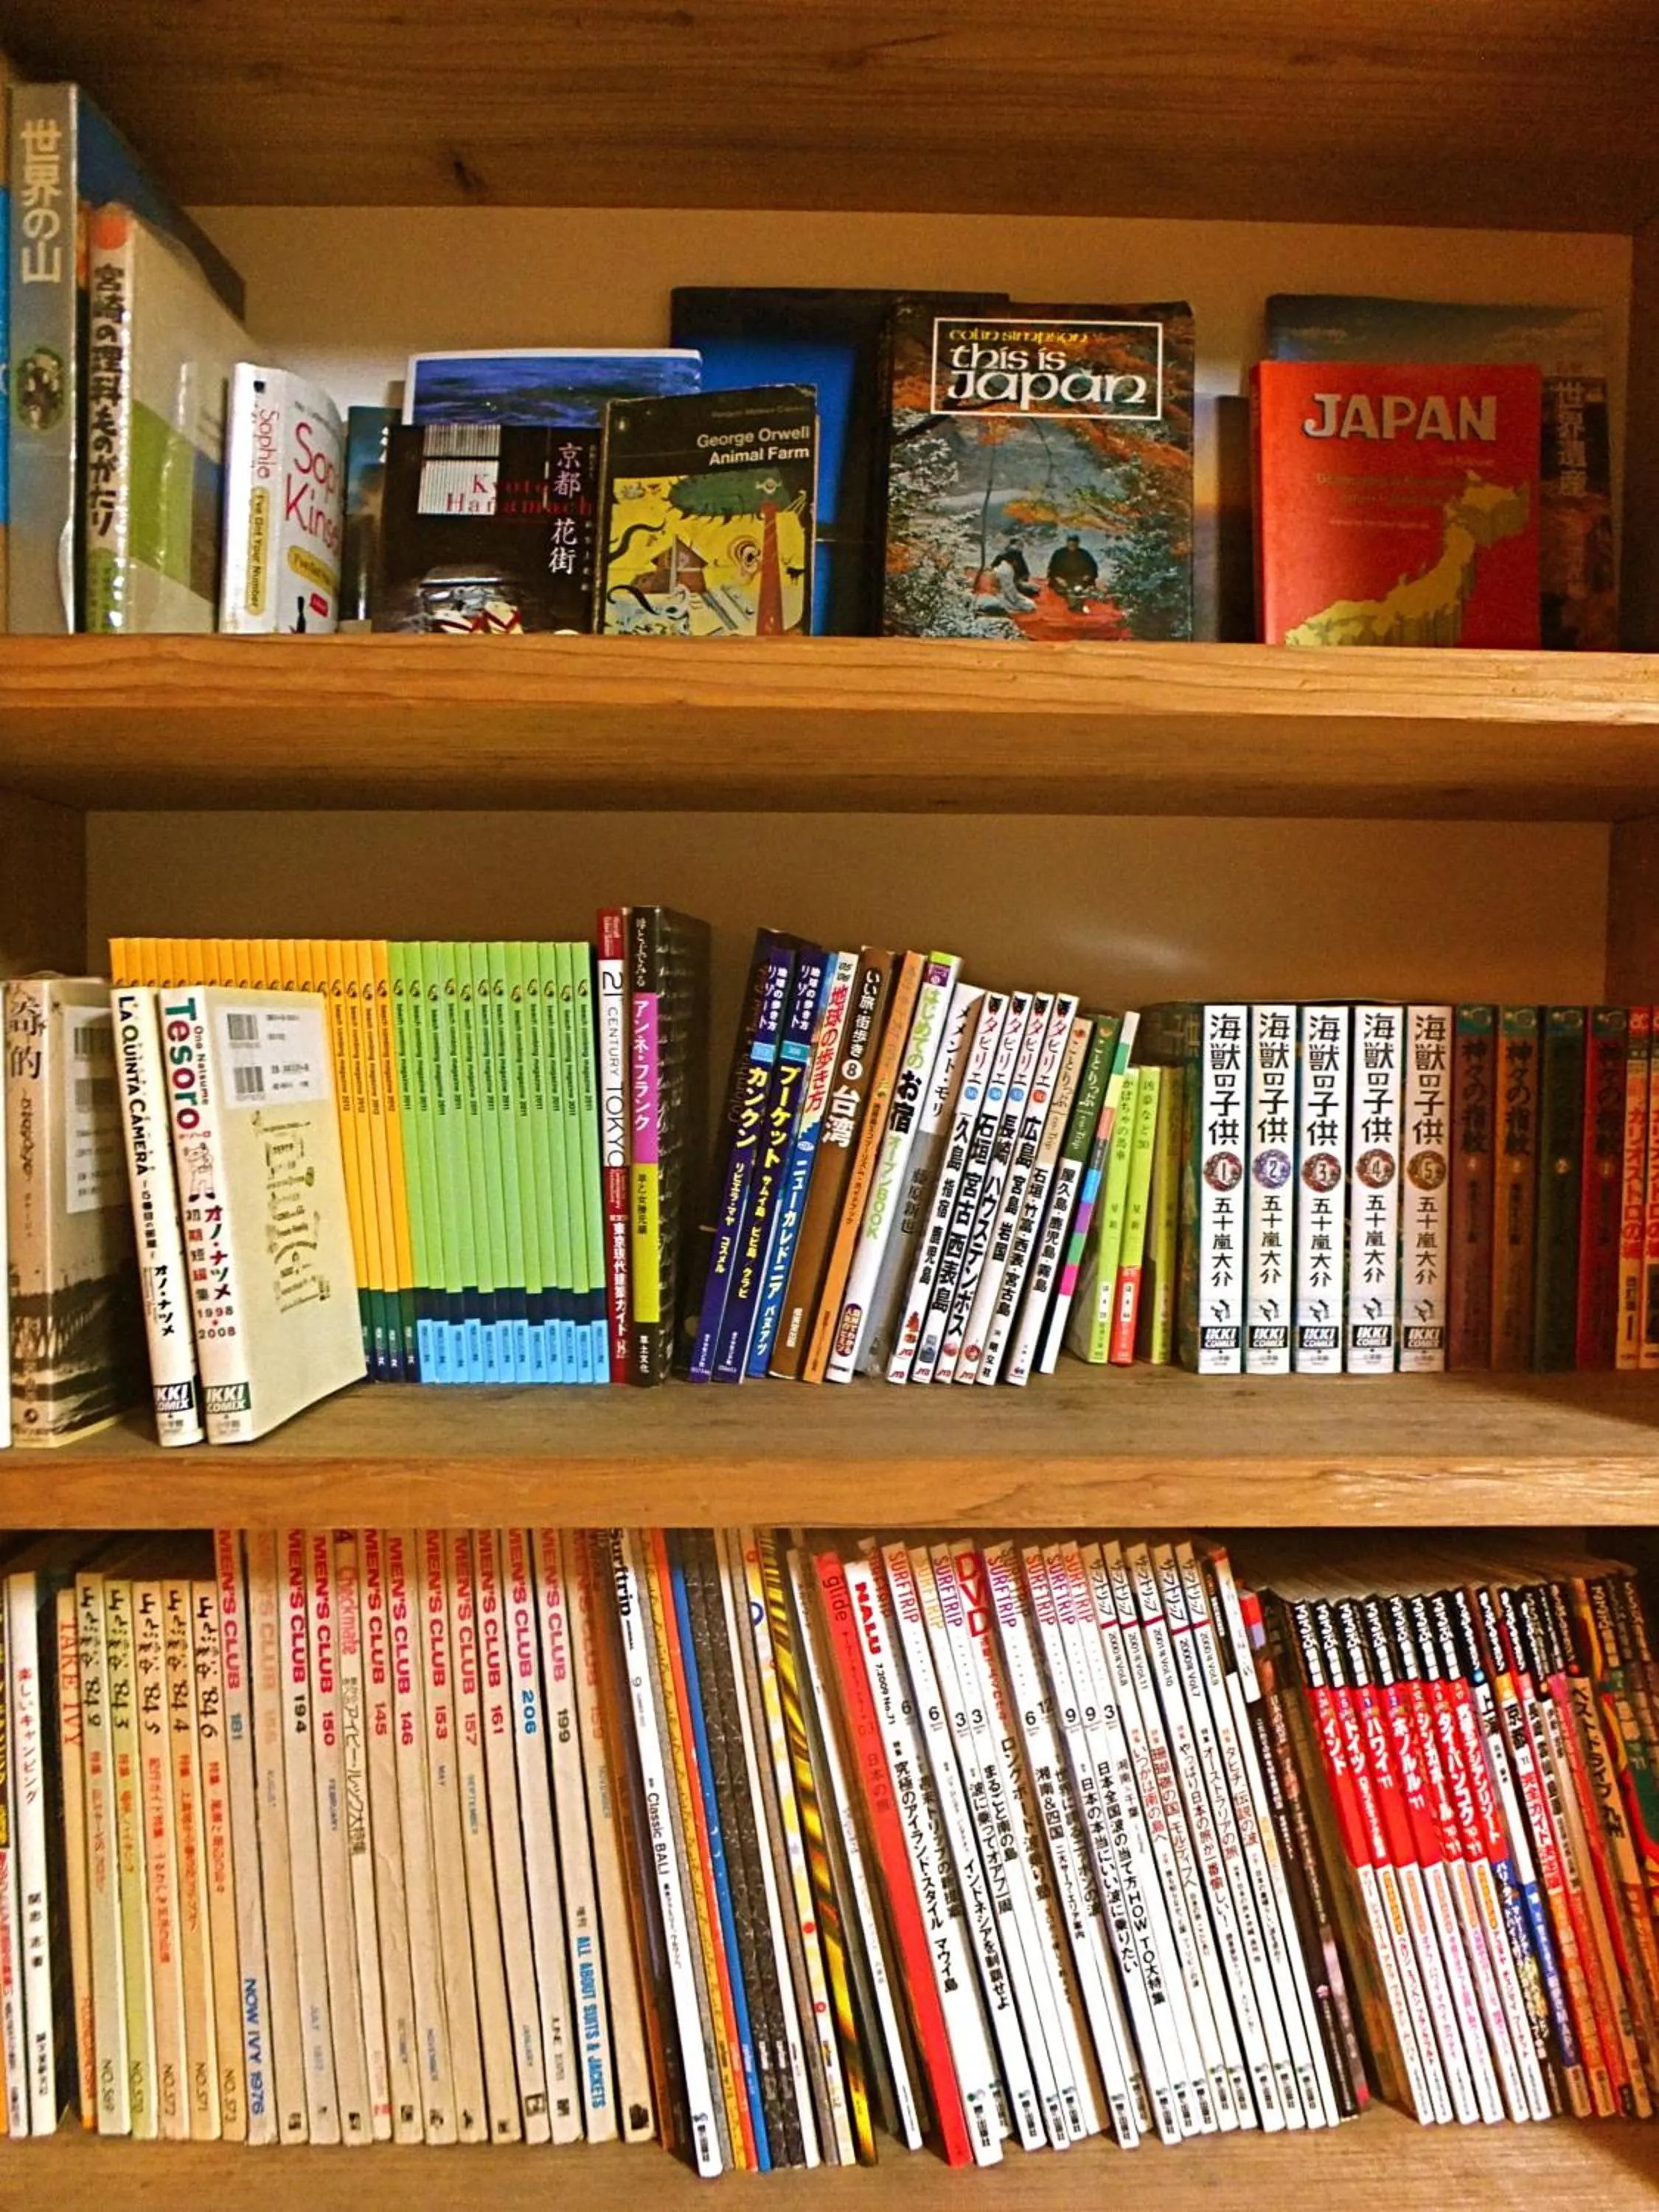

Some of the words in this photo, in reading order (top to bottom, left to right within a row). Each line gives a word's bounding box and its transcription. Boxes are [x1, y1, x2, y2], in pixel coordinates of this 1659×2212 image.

[21, 119, 61, 283] 世界の山
[1037, 347, 1067, 371] is
[258, 408, 279, 479] Sophie
[697, 432, 754, 448] George
[758, 425, 810, 442] Orwell
[1304, 393, 1497, 441] JAPAN
[554, 442, 582, 498] 京都
[709, 448, 764, 466] Animal
[768, 447, 810, 461] Farm
[549, 519, 578, 575] 花街
[759, 964, 777, 1030] リゾート
[791, 964, 810, 1029] リゾート
[165, 998, 201, 1130] Tesoro
[607, 1006, 619, 1076] CENTURY
[633, 1000, 650, 1131] アンネ・フランク
[806, 984, 849, 1115] 地球の歩き方
[931, 1007, 971, 1119] メメント・モリ
[967, 1016, 998, 1085] タビリエ
[990, 1016, 1023, 1085] タビリエ
[1013, 1016, 1043, 1087] タビリエ
[1034, 1017, 1067, 1088] タビリエ
[736, 1066, 769, 1148] カンクン
[888, 1070, 922, 1135] お宿
[1209, 1013, 1241, 1147] 海獣の子供
[1258, 1012, 1290, 1144] 海獣の子供
[1307, 1015, 1340, 1147] 海獣の子供
[1362, 1012, 1395, 1144] 海獣の子供
[1413, 1015, 1447, 1147] 海獣の子供
[129, 1099, 149, 1176] CAMERA
[605, 1082, 626, 1168] TOKYO
[763, 1065, 801, 1171] プーケット
[821, 1085, 861, 1149] 台湾
[970, 1114, 998, 1166] 石垣
[1015, 1115, 1042, 1170] 広島
[956, 1172, 983, 1227] 宮古
[1004, 1175, 1027, 1216] 宮島
[204, 1205, 232, 1301] オノ・ナツメ
[768, 1159, 807, 1300] ニューカレドニア
[949, 1176, 1002, 1337] ハウステンボス
[1211, 1197, 1235, 1287] 五十嵐大介
[1260, 1195, 1283, 1284] 五十嵐大介
[1310, 1197, 1333, 1288] 五十嵐大介
[1363, 1194, 1386, 1284] 五十嵐大介
[1414, 1197, 1439, 1285] 五十嵐大介
[931, 1232, 967, 1314] 西表島
[196, 1306, 234, 1318] 1998
[198, 1327, 236, 1339] 2008
[1206, 1329, 1237, 1340] IKKI
[1255, 1329, 1284, 1340] IKKI
[219, 1530, 237, 1615] MEN'S
[288, 1530, 305, 1608] MEN'S
[313, 1536, 330, 1620] MEN'S
[364, 1530, 381, 1611] MEN'S
[389, 1536, 407, 1621] MEN'S
[823, 1575, 848, 1622] glide
[954, 1551, 992, 1638] DVD
[291, 1613, 306, 1684] CLUB
[369, 1615, 385, 1686] CLUB
[855, 1582, 882, 1655] NALU
[889, 1550, 919, 1623] SURFTRIP
[928, 1705, 940, 1721] 6
[933, 1554, 963, 1627] SURFTRIP
[971, 1708, 983, 1725] 3
[987, 1554, 1017, 1629] SURFTRIP
[1025, 1711, 1037, 1727] 6
[1026, 1553, 1055, 1627] SURFTRIP
[1065, 1707, 1077, 1724] 9
[1294, 1604, 1317, 1649] るるぶ
[1316, 1604, 1338, 1649] るるぶ
[1340, 1604, 1361, 1649] るるぶ
[1366, 1601, 1385, 1648] るるぶ
[1390, 1596, 1411, 1643] るるぶ
[60, 1622, 80, 1689] TAKE
[222, 1619, 240, 1690] CLUB
[316, 1624, 333, 1694] CLUB
[393, 1625, 411, 1694] CLUB
[62, 1702, 83, 1747] IVY
[293, 1694, 307, 1734] 194
[321, 1711, 335, 1746] 150
[374, 1701, 387, 1736] 145
[400, 1711, 413, 1746] 146
[435, 1705, 448, 1740] 153
[465, 1711, 478, 1747] 157
[490, 1705, 504, 1735] 161
[521, 1689, 536, 1735] 206
[557, 1708, 571, 1744] 199
[955, 1712, 967, 1728] 3
[1085, 1705, 1096, 1722] 9
[1104, 1704, 1116, 1720] 3
[1324, 1719, 1347, 1775] インド
[1345, 1718, 1365, 1773] ドイツ
[1367, 1719, 1388, 1775] ハワイ
[1391, 1718, 1421, 1793] ホノルル
[654, 1841, 671, 1876] BALI
[576, 1936, 591, 1957] ALL
[934, 1938, 959, 1993] マウイ島
[245, 1978, 259, 2025] NOW
[579, 1963, 597, 2001] ABOUT
[249, 2031, 262, 2065] IVY
[582, 2004, 599, 2041] SUITS
[251, 2069, 264, 2115] 1976
[588, 2055, 607, 2110] JACKETS
